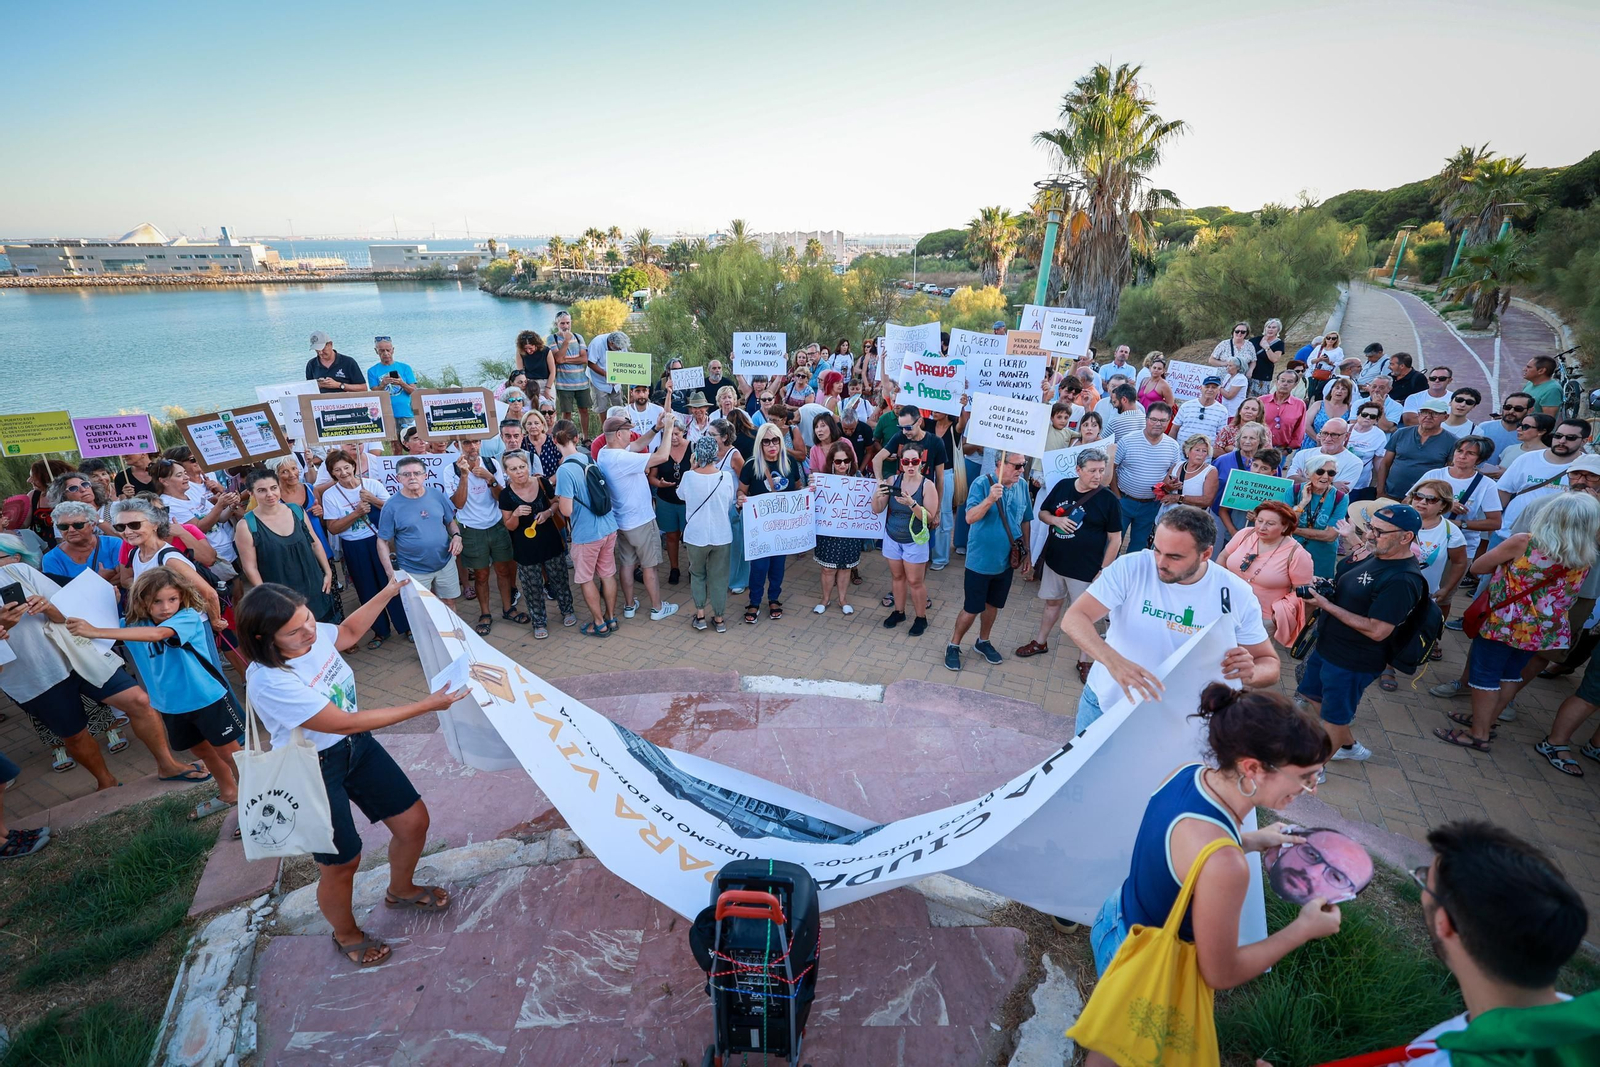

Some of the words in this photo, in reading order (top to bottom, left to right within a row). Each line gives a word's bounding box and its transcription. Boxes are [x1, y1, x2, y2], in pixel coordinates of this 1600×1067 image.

[1053, 317, 1083, 325] LIMITACIÓN
[960, 334, 967, 343] EL
[971, 335, 999, 347] PUERTO
[1050, 331, 1079, 339] TURÍSTICOS
[955, 344, 971, 357] NO
[984, 358, 992, 367] EL
[1000, 358, 1027, 368] PUERTO
[674, 368, 703, 380] STRESS
[914, 361, 956, 378] PARAGUAS
[999, 370, 1029, 379] AVANZA
[1169, 371, 1200, 383] AVANZA
[918, 379, 952, 401] ÁRBOLES
[989, 404, 1006, 412] ¿QUÉ
[1007, 407, 1028, 416] PASA?
[234, 416, 255, 425] ¡BASTA
[989, 413, 1005, 421] ¿QUÉ
[1006, 416, 1028, 425] PASA?
[193, 425, 214, 434] ¡BASTA
[1004, 425, 1035, 436] TENEMOS
[996, 432, 1014, 440] CASA
[383, 460, 395, 470] EL
[816, 475, 831, 489] EL
[840, 478, 877, 494] PUERT
[1250, 481, 1286, 493] TERRAZAS
[815, 489, 873, 508] AVANZA
[1249, 488, 1275, 498] QUITAN
[815, 505, 826, 515] EN
[831, 507, 878, 521] SUELDOS
[836, 521, 848, 530] LOS
[851, 521, 882, 533] AMIGOS)
[272, 789, 300, 810] WILD
[651, 804, 674, 822] DE
